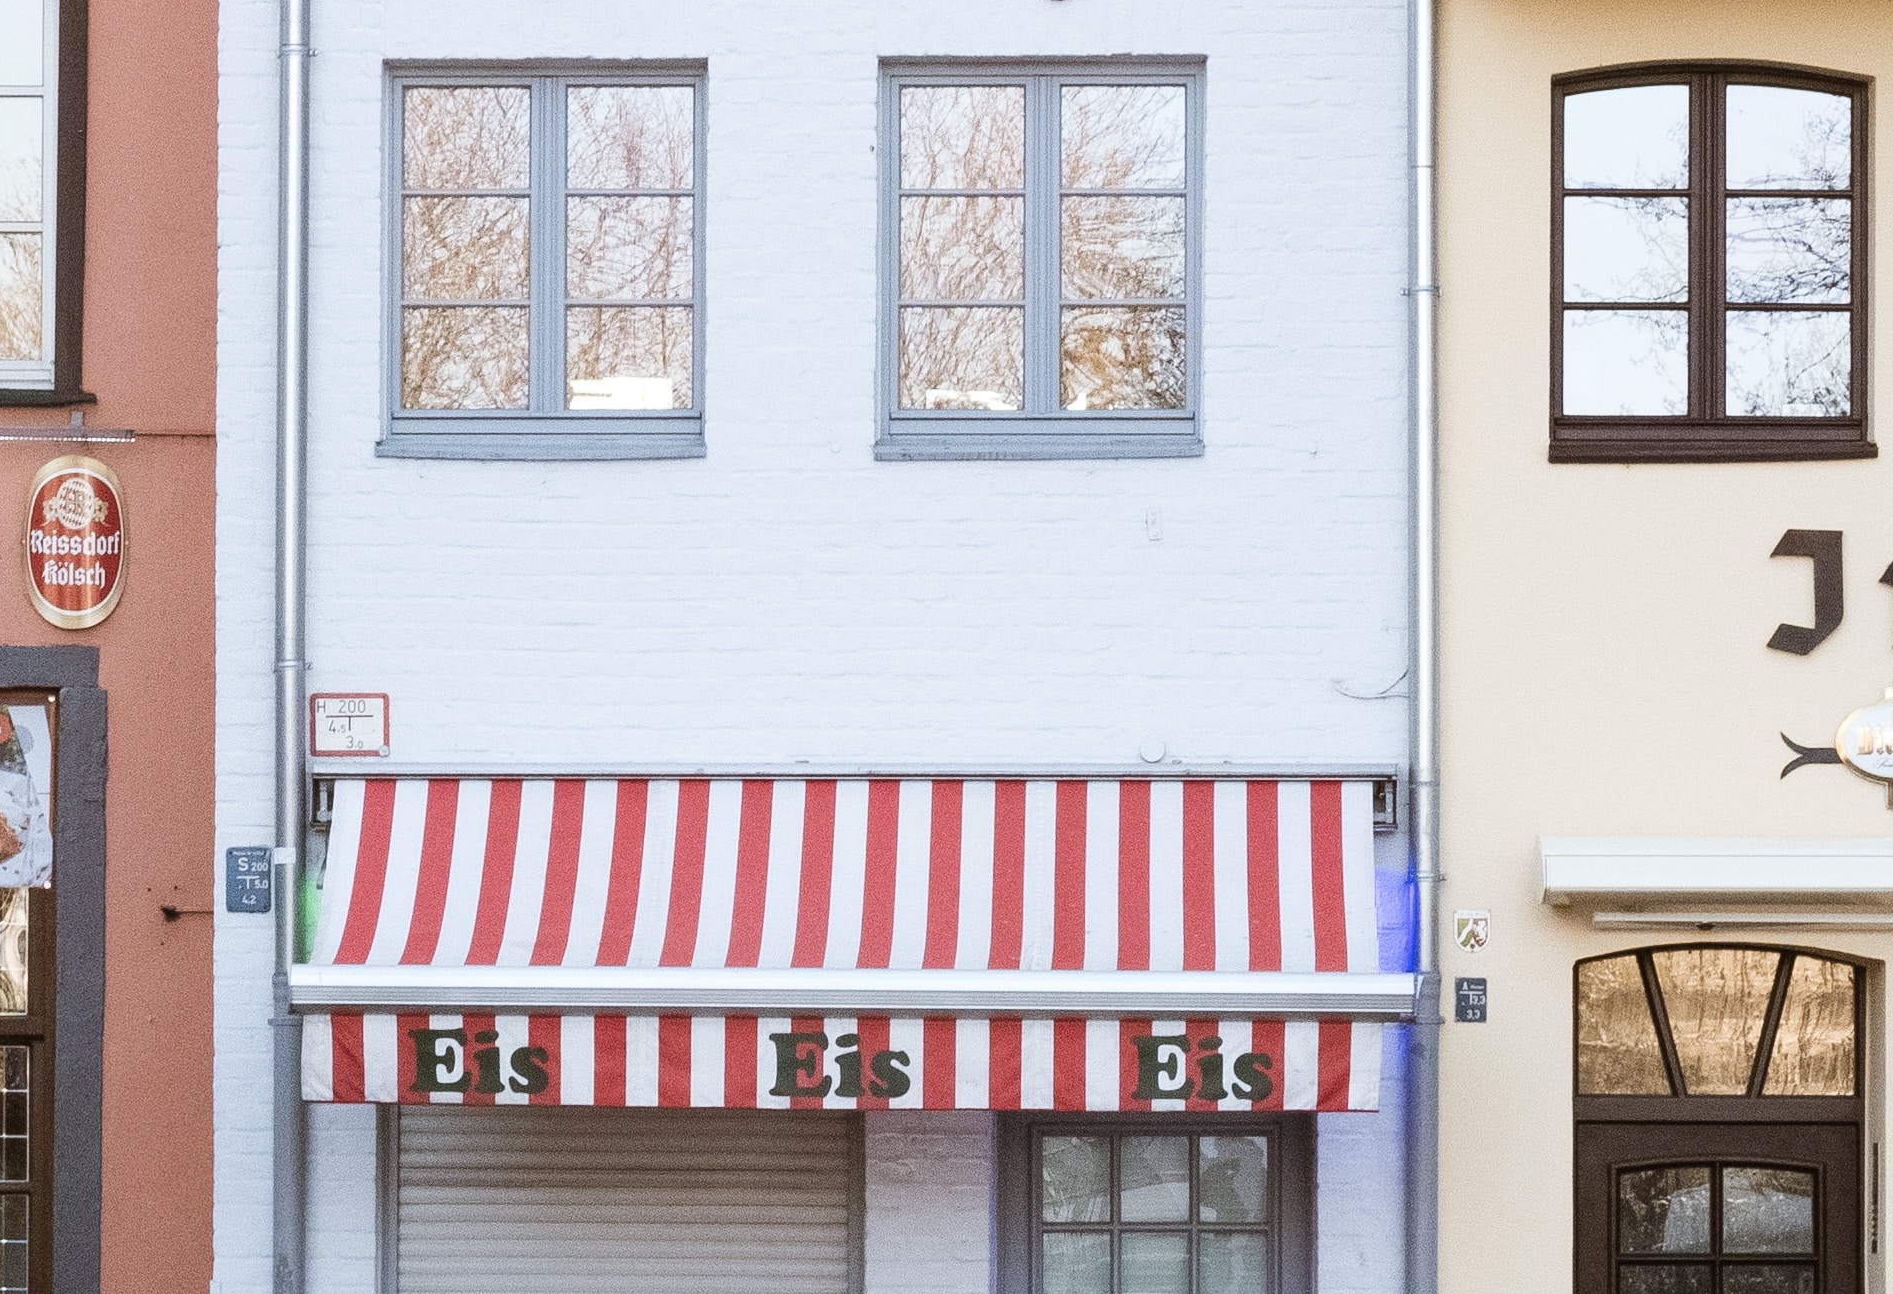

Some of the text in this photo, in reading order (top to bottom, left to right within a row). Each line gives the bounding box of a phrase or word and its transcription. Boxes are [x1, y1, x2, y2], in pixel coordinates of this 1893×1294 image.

[30, 528, 120, 557] Reissdorf
[42, 558, 106, 589] Kölsch
[316, 699, 366, 714] H 200
[237, 856, 269, 872] S 200
[407, 1027, 551, 1095] Eis
[768, 1032, 911, 1100] Eis
[1132, 1036, 1275, 1102] Eis
